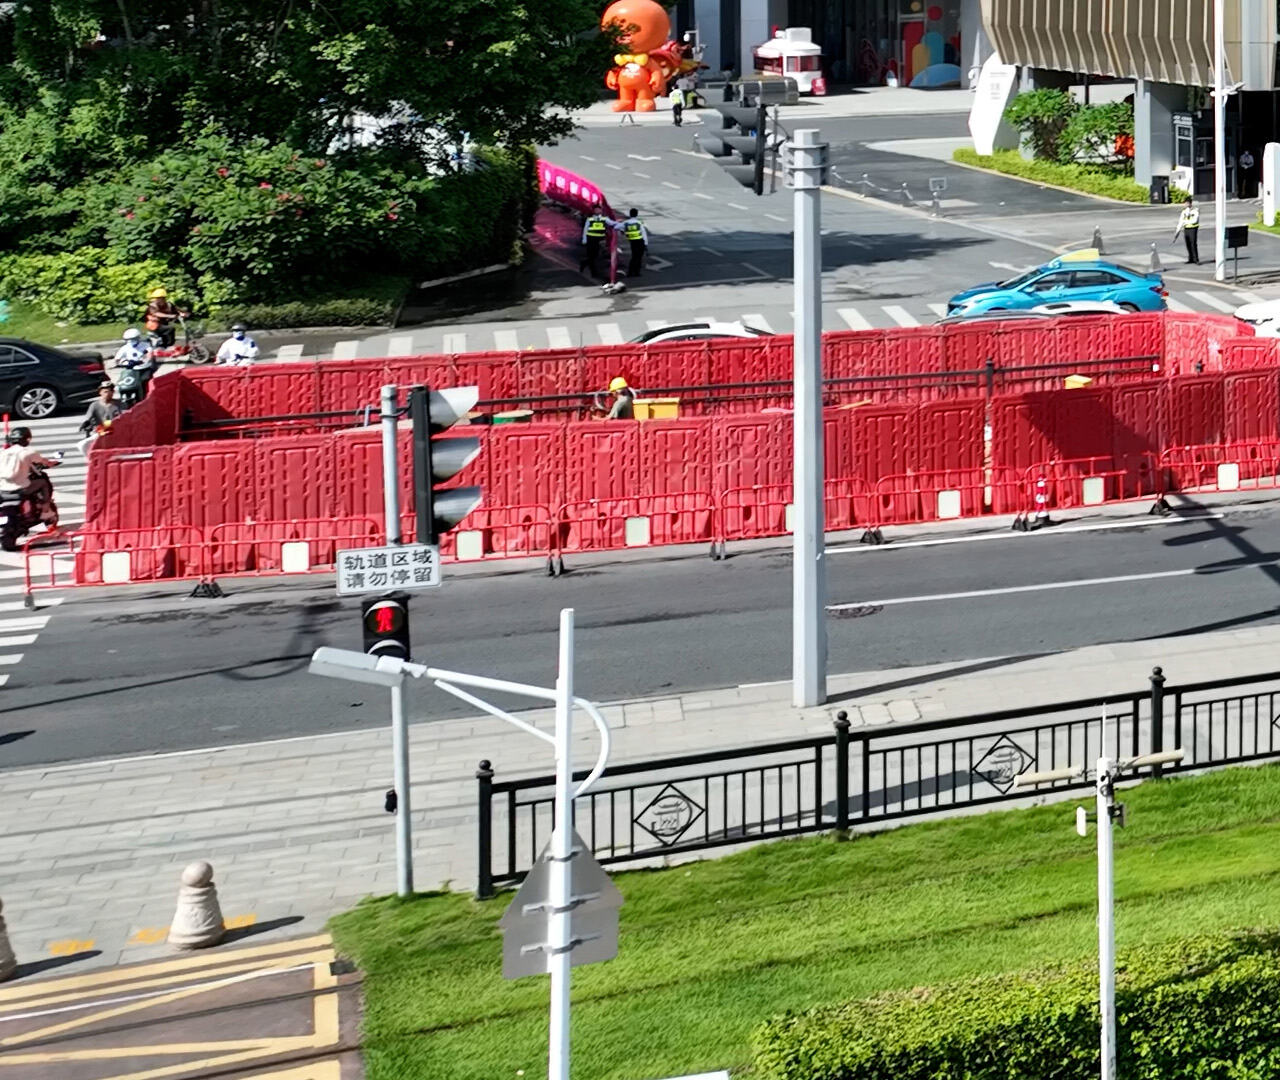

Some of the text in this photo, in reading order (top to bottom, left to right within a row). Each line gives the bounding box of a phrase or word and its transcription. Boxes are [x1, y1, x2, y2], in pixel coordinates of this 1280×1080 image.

[344, 549, 433, 571] 轨道区域
[344, 566, 432, 588] 请勿停留
